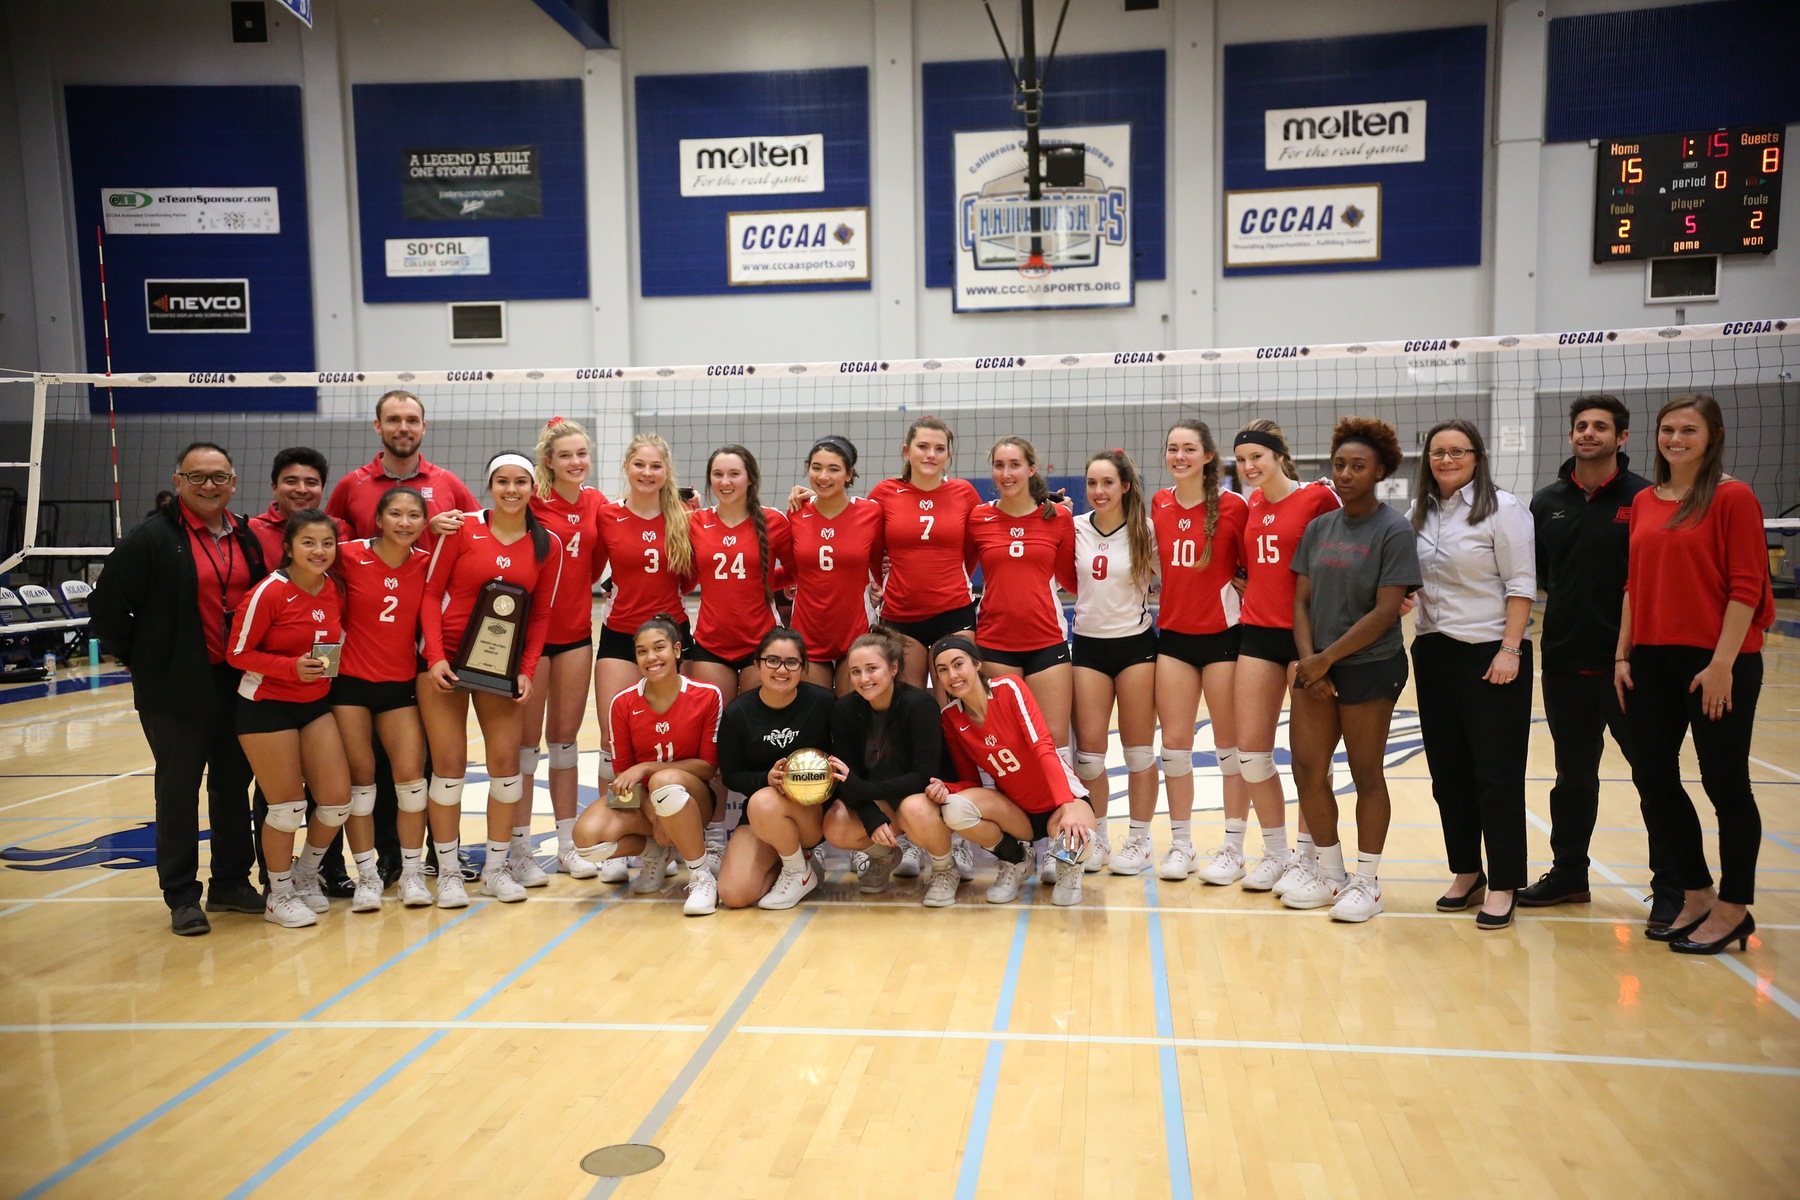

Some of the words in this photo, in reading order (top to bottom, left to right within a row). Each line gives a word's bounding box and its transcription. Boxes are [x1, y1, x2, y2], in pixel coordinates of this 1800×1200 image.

[1283, 110, 1409, 141] molten
[1741, 133, 1779, 146] Guests
[697, 141, 808, 169] molten
[1084, 145, 1115, 168] ollege
[1278, 146, 1302, 161] For
[1305, 144, 1329, 158] the
[1332, 142, 1363, 157] real
[1366, 144, 1409, 160] game
[1611, 143, 1640, 156] Home
[409, 154, 420, 167] A
[423, 153, 476, 167] LEGEND
[478, 152, 491, 165] IS
[494, 151, 531, 164] BUILT
[1762, 147, 1780, 173] 8
[409, 166, 434, 178] ONE
[436, 166, 471, 178] STORY
[474, 165, 488, 176] AT
[489, 165, 499, 175] A
[1621, 158, 1643, 184] 15
[692, 174, 714, 188] For
[717, 174, 738, 186] the
[741, 173, 768, 186] real
[771, 175, 809, 189] game
[1672, 175, 1707, 190] period
[1714, 170, 1727, 189] 0
[158, 194, 271, 205] eTeamSponsor.com
[1671, 198, 1705, 211] player
[1743, 194, 1769, 206] fouls
[1610, 203, 1635, 215] fouls
[1239, 205, 1334, 234] CCCAA
[1685, 215, 1697, 234] 5
[1750, 210, 1763, 229] 2
[1618, 219, 1631, 238] 2
[742, 223, 826, 250] CCCAA
[1743, 236, 1764, 247] won
[1611, 244, 1631, 254] won
[1673, 240, 1700, 252] game
[742, 260, 856, 271] www.cccaasports.org
[169, 297, 241, 310] NEVCO
[1722, 320, 1772, 336] CCCAA
[1558, 331, 1604, 345] CCCAA
[1256, 347, 1298, 359] CCCAA
[1403, 340, 1447, 352] CCCAA
[975, 356, 1014, 369] CCCAA
[1114, 352, 1154, 364] CCCAA
[576, 368, 613, 379] CCCAA
[707, 365, 744, 376] CCCAA
[839, 361, 878, 373] CCCAA
[188, 372, 226, 384] CCCAA
[318, 372, 355, 383] CCCAA
[447, 370, 484, 381] CCCAA
[919, 515, 934, 541] 7
[566, 531, 581, 558] 4
[1256, 534, 1280, 564] 15
[819, 545, 834, 571] 6
[1171, 538, 1196, 567] 10
[644, 548, 659, 574] 3
[712, 552, 746, 580] 24
[1091, 555, 1108, 581] 9
[23, 589, 48, 598] SOLANO
[64, 585, 90, 594] SOLANO
[379, 595, 399, 623] 2
[654, 742, 674, 763] 11
[987, 748, 1021, 777] 19
[792, 772, 826, 782] molten
